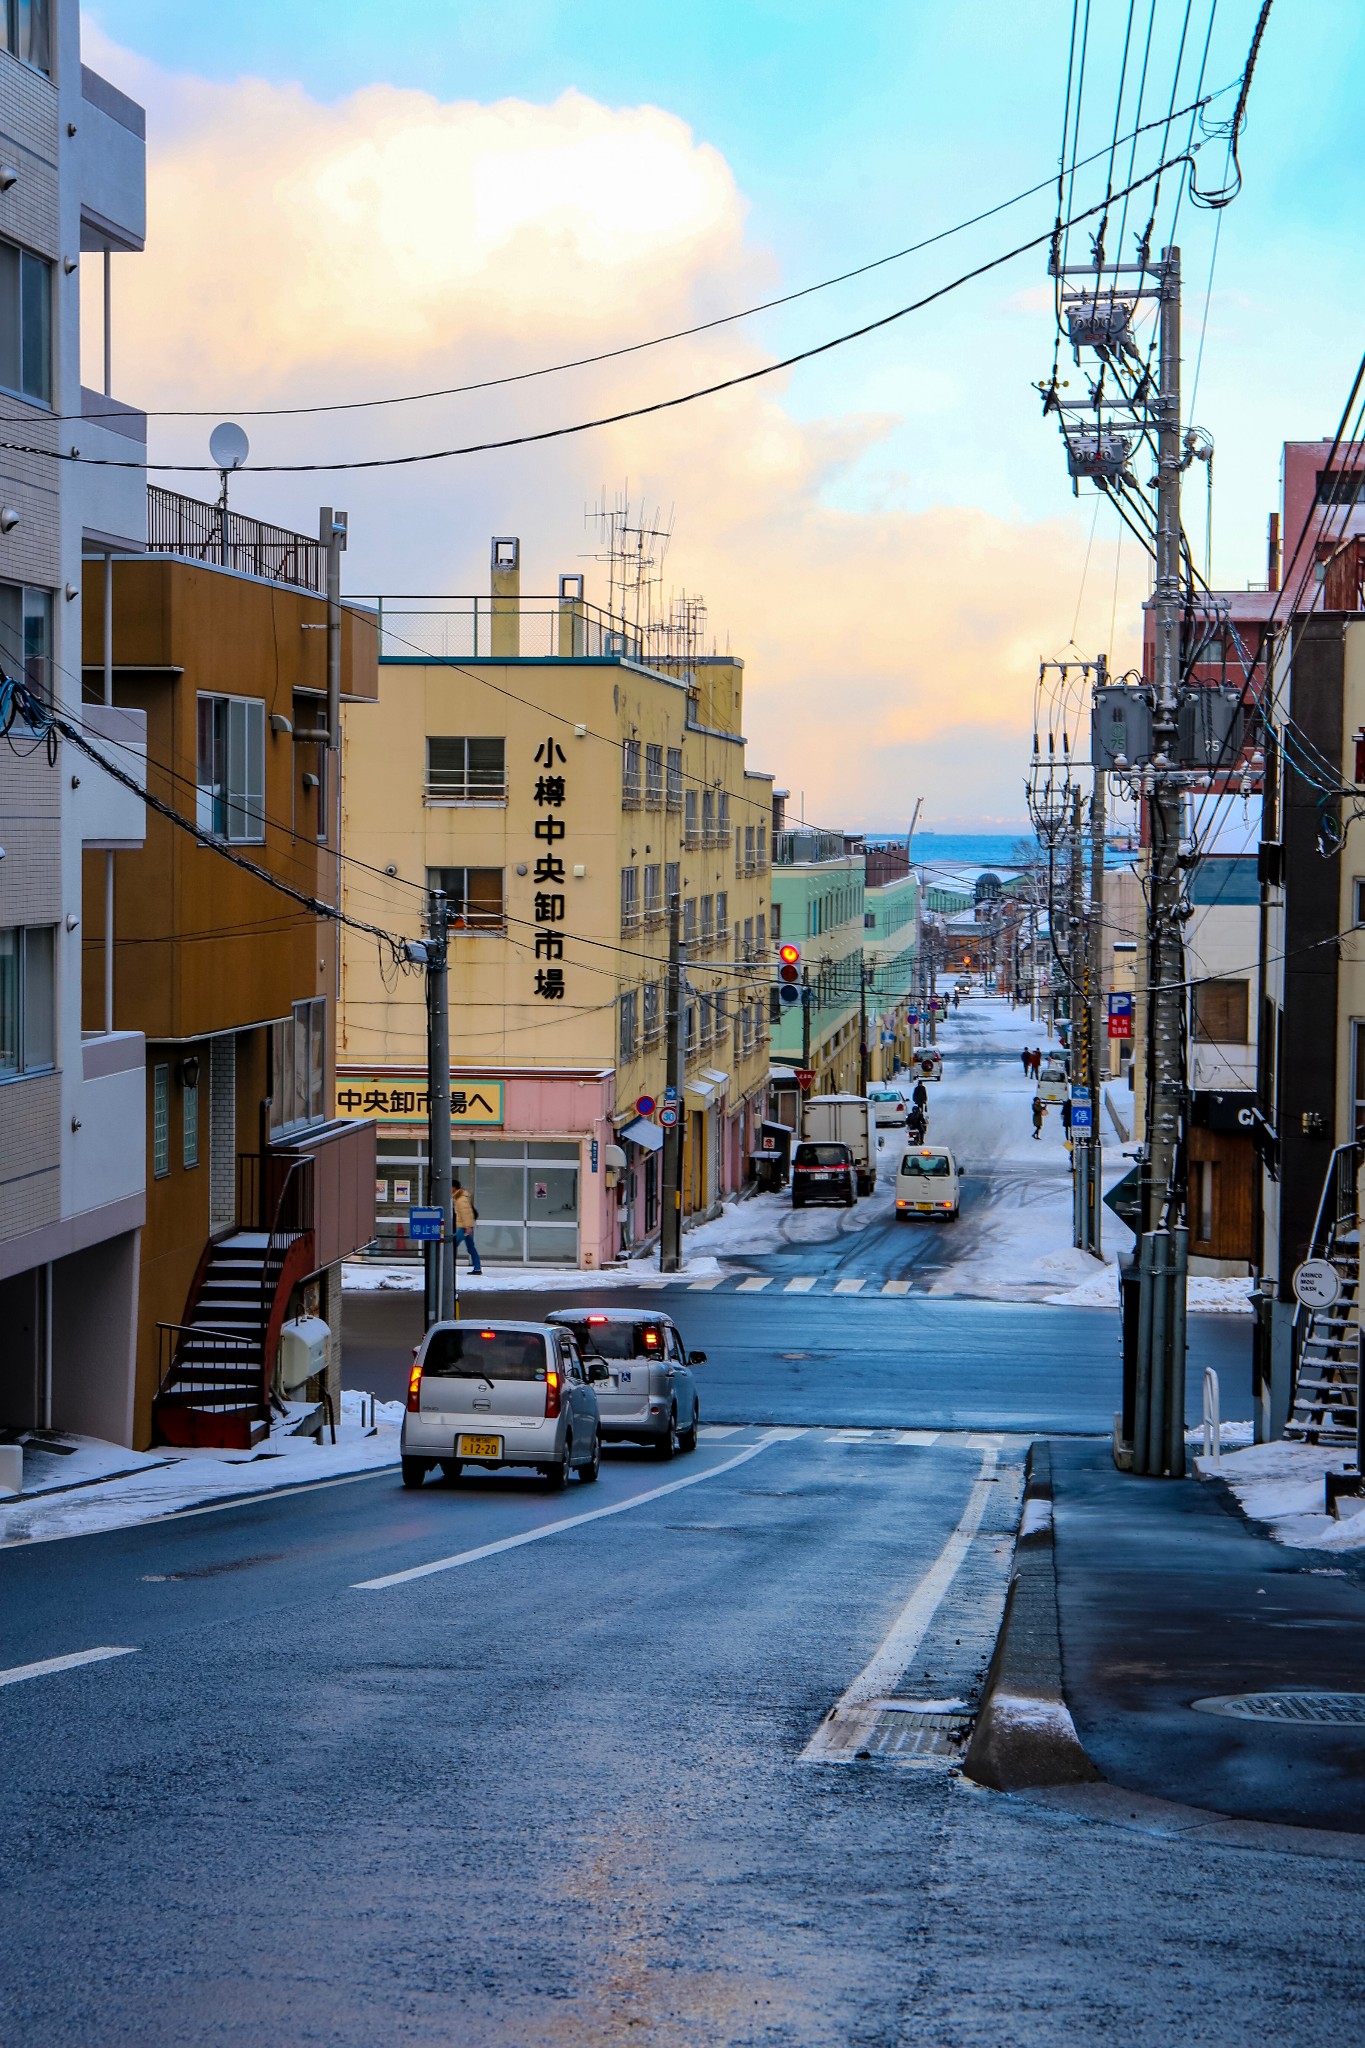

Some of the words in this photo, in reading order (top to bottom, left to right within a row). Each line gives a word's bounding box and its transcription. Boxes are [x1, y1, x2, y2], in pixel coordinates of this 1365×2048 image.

[1110, 738, 1125, 750] 75
[533, 736, 567, 1000] 小樽中央卸市場
[1112, 997, 1129, 1013] P
[663, 1112, 675, 1122] 30
